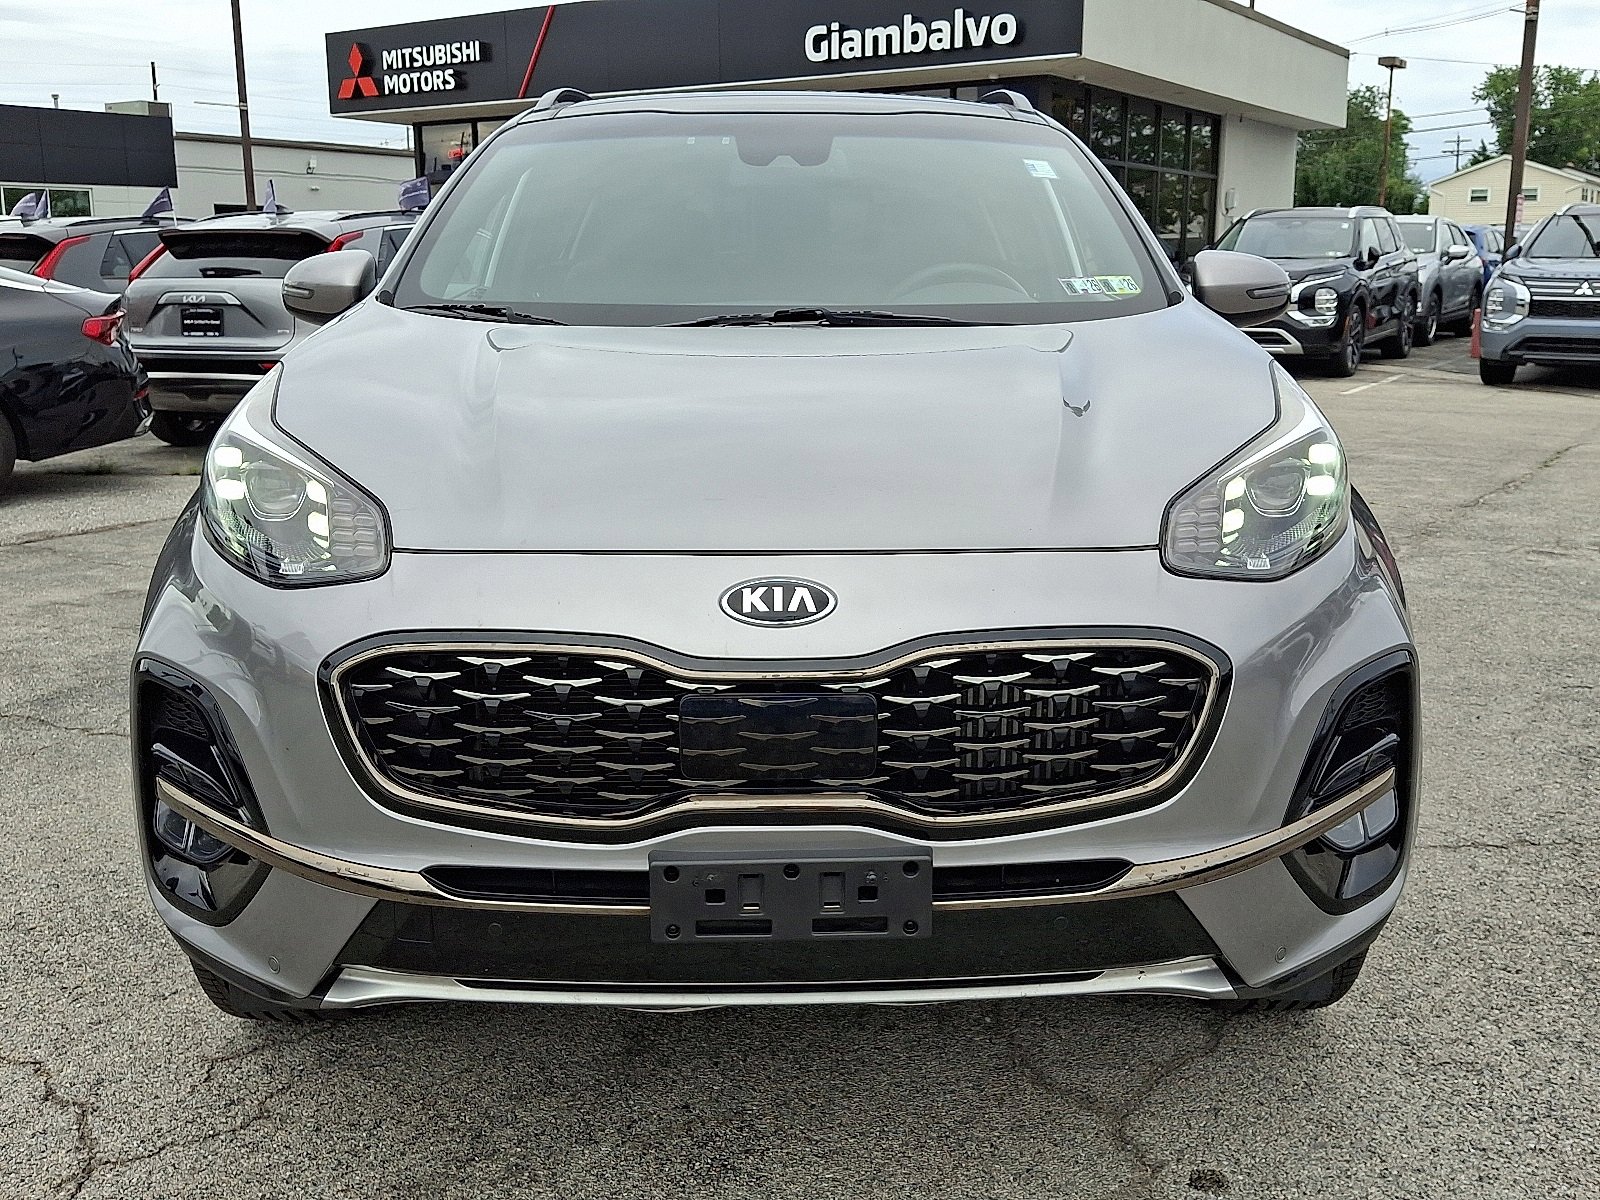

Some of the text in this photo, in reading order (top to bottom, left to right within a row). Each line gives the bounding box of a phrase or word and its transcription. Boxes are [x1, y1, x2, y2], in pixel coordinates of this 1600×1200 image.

[804, 8, 1017, 62] Giambalvo
[382, 40, 480, 70] MITSUBISHI
[383, 69, 455, 95] MOTORS
[741, 586, 818, 613] KIA
